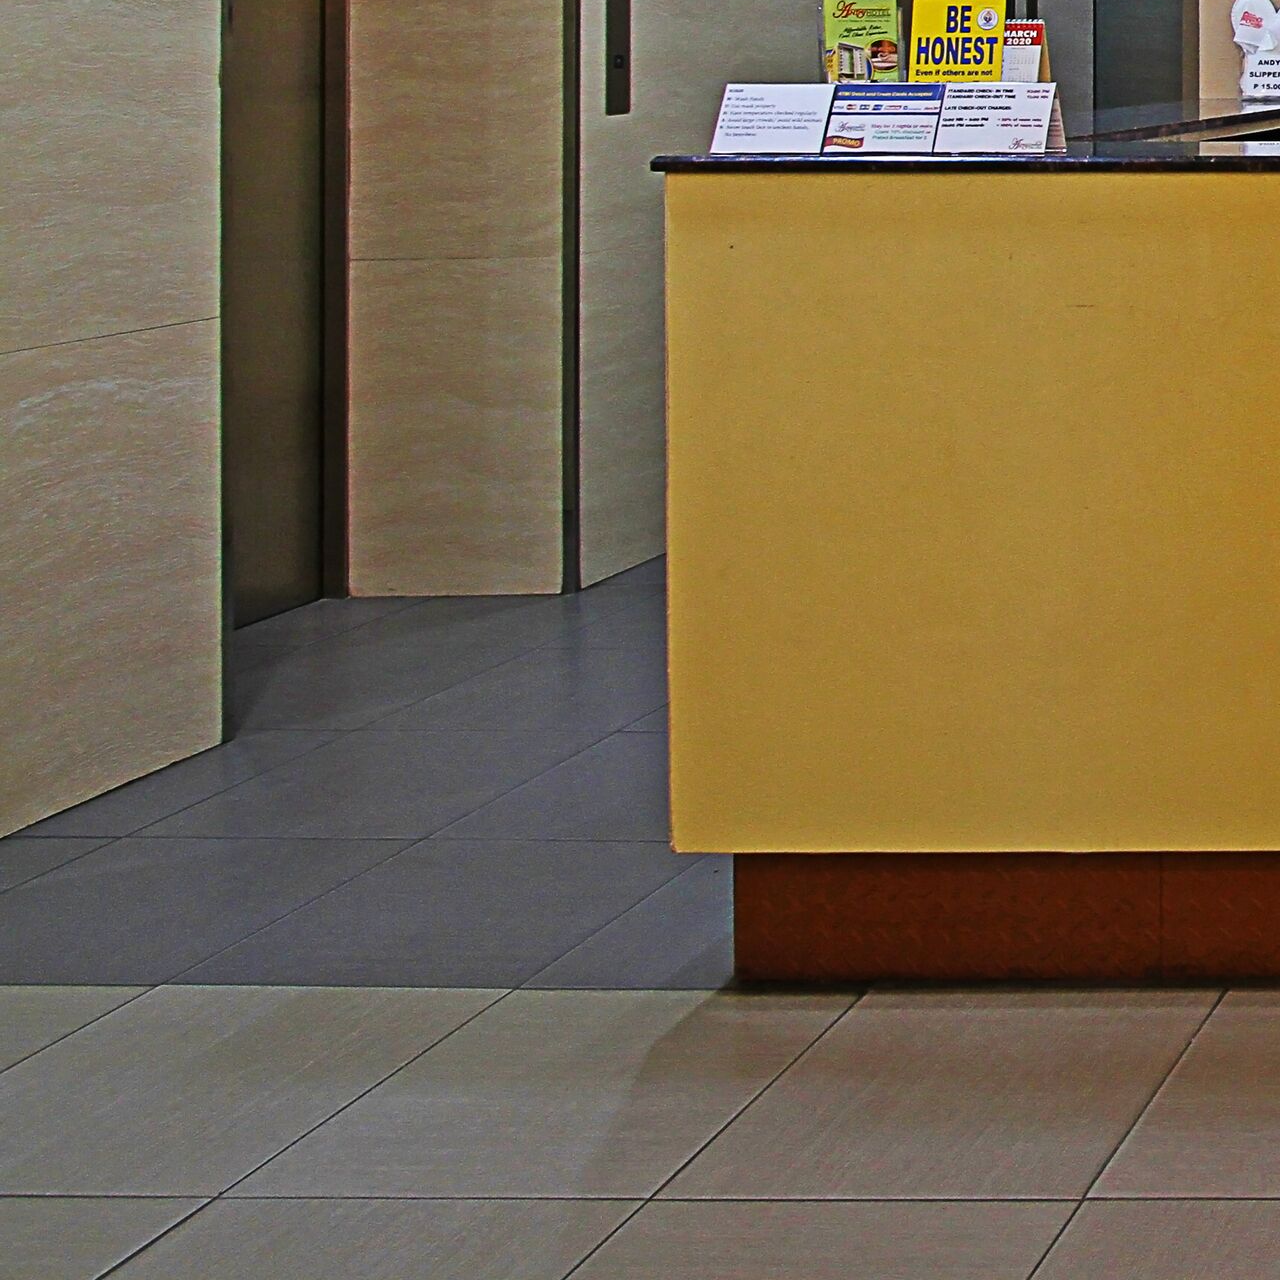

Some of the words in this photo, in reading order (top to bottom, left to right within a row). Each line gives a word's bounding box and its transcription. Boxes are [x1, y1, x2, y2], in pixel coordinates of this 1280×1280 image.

[946, 5, 972, 33] BE
[916, 36, 998, 65] HONEST
[942, 69, 965, 77] others
[832, 138, 860, 146] PROMO
